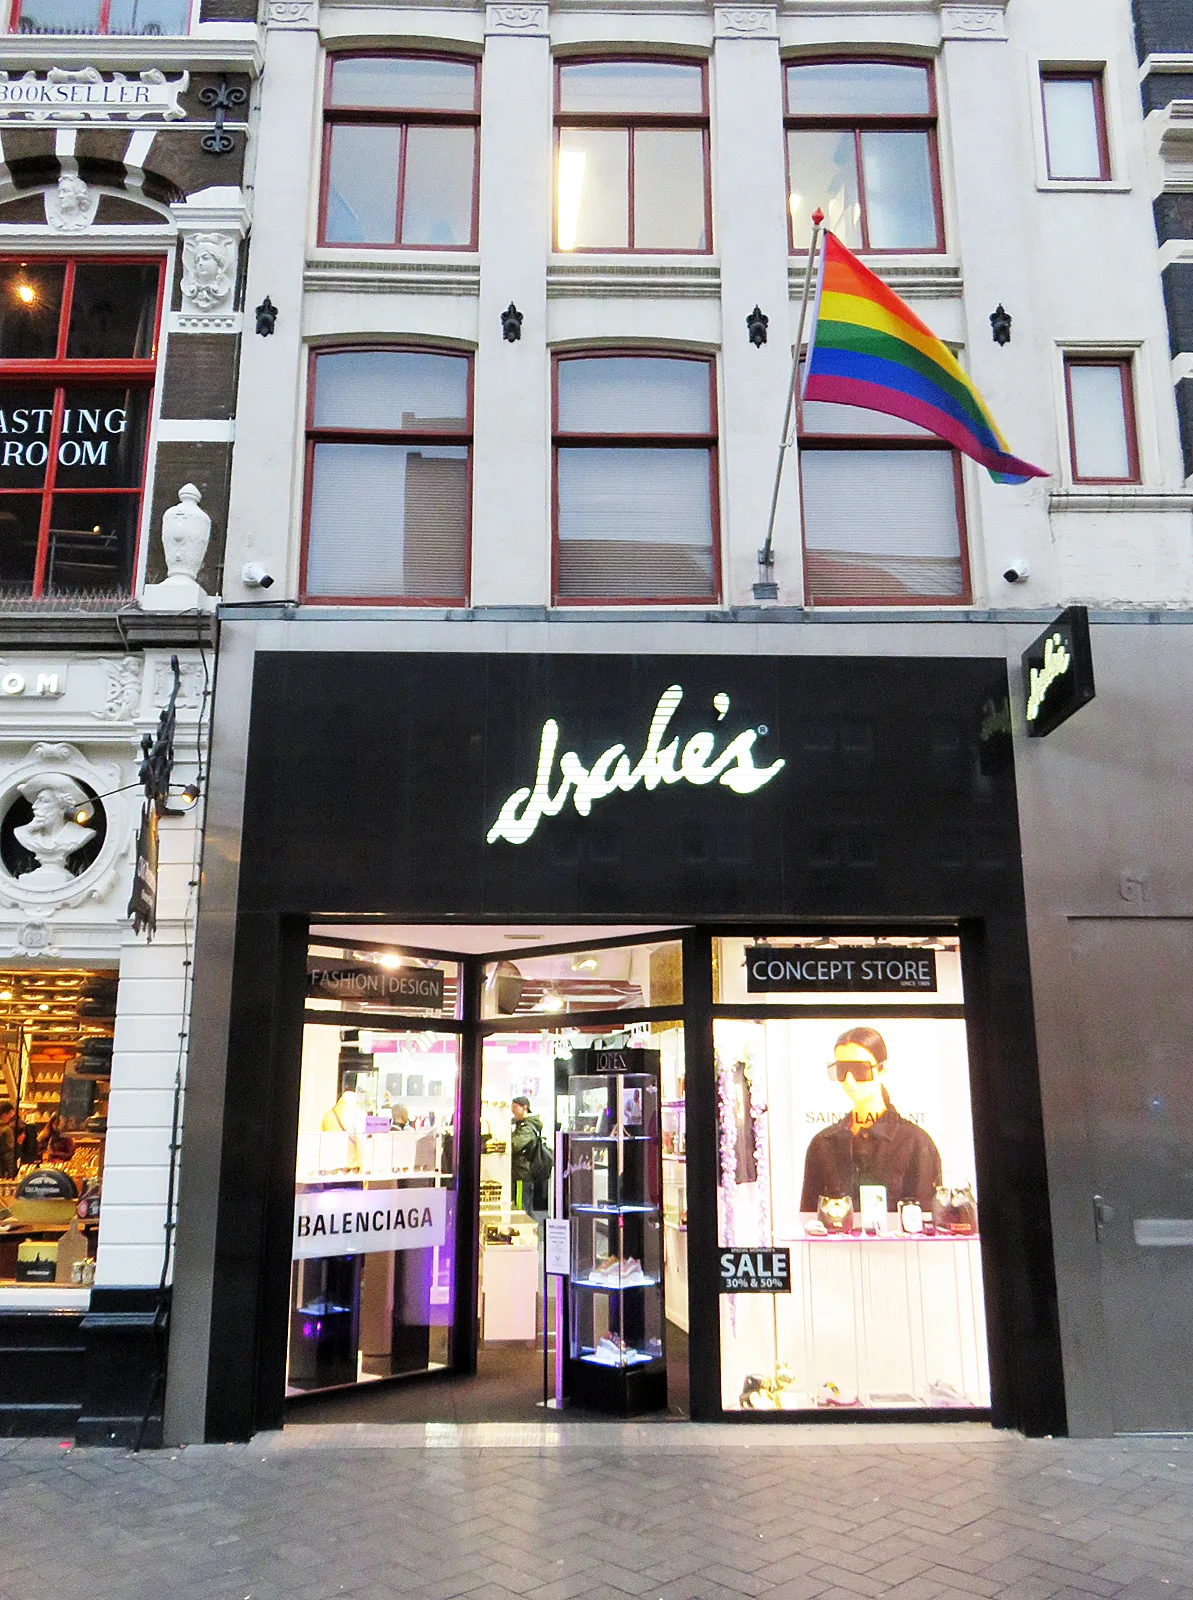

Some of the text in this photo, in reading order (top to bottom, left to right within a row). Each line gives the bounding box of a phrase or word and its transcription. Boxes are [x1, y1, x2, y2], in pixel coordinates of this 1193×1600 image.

[1, 440, 109, 467] ROOM
[752, 960, 931, 980] CONCEPT STORE
[311, 969, 440, 997] FASHION DESIGN
[297, 1207, 433, 1237] BALENCIAGA
[720, 1253, 787, 1277] SALE
[726, 1278, 783, 1288] 30% & 50%
